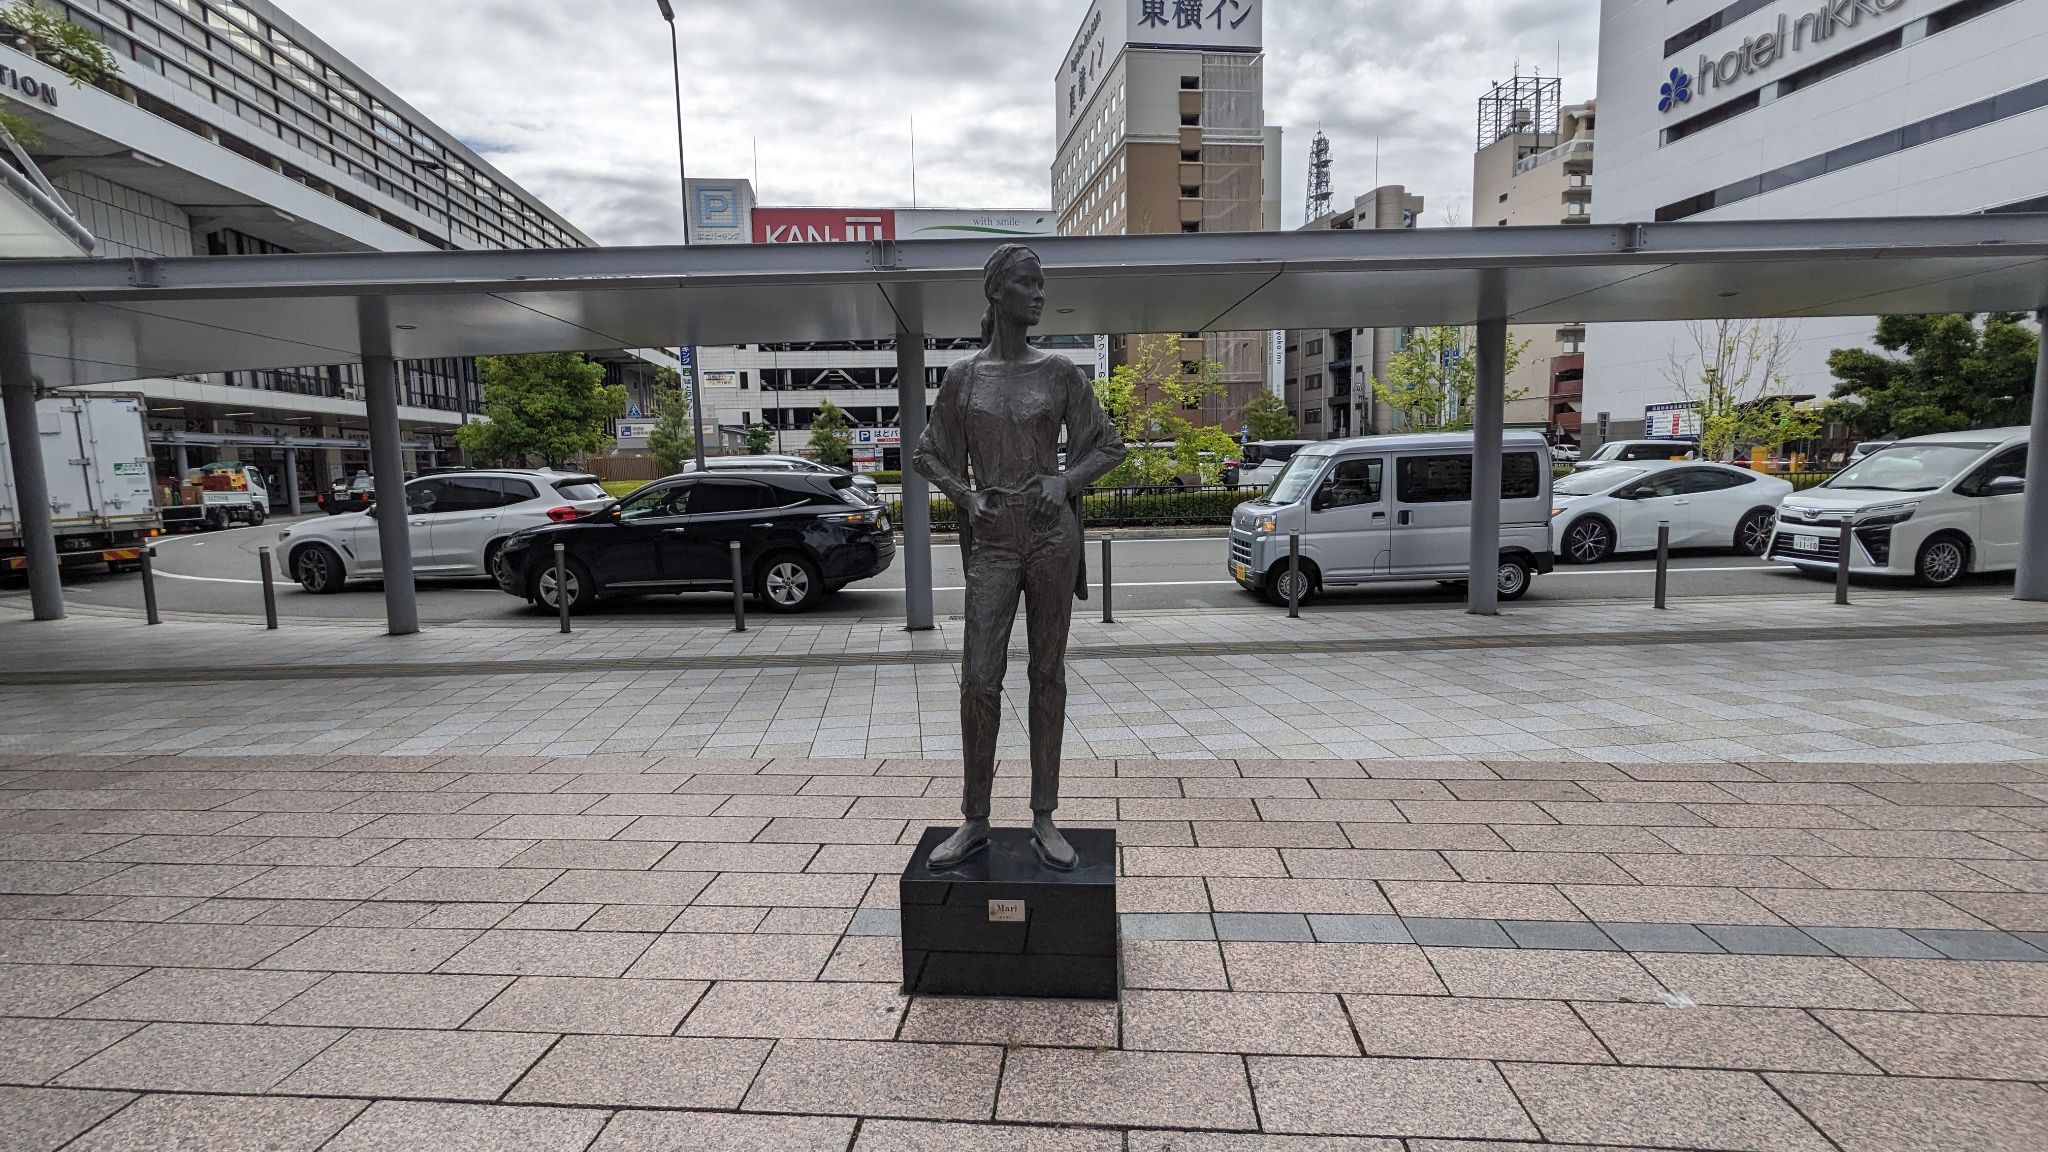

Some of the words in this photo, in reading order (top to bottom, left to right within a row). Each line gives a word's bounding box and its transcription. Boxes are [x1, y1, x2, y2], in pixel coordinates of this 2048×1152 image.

[1697, 12, 1786, 95] hotel
[973, 216, 992, 226] with
[996, 216, 1020, 226] smile
[874, 429, 900, 438] はとパ
